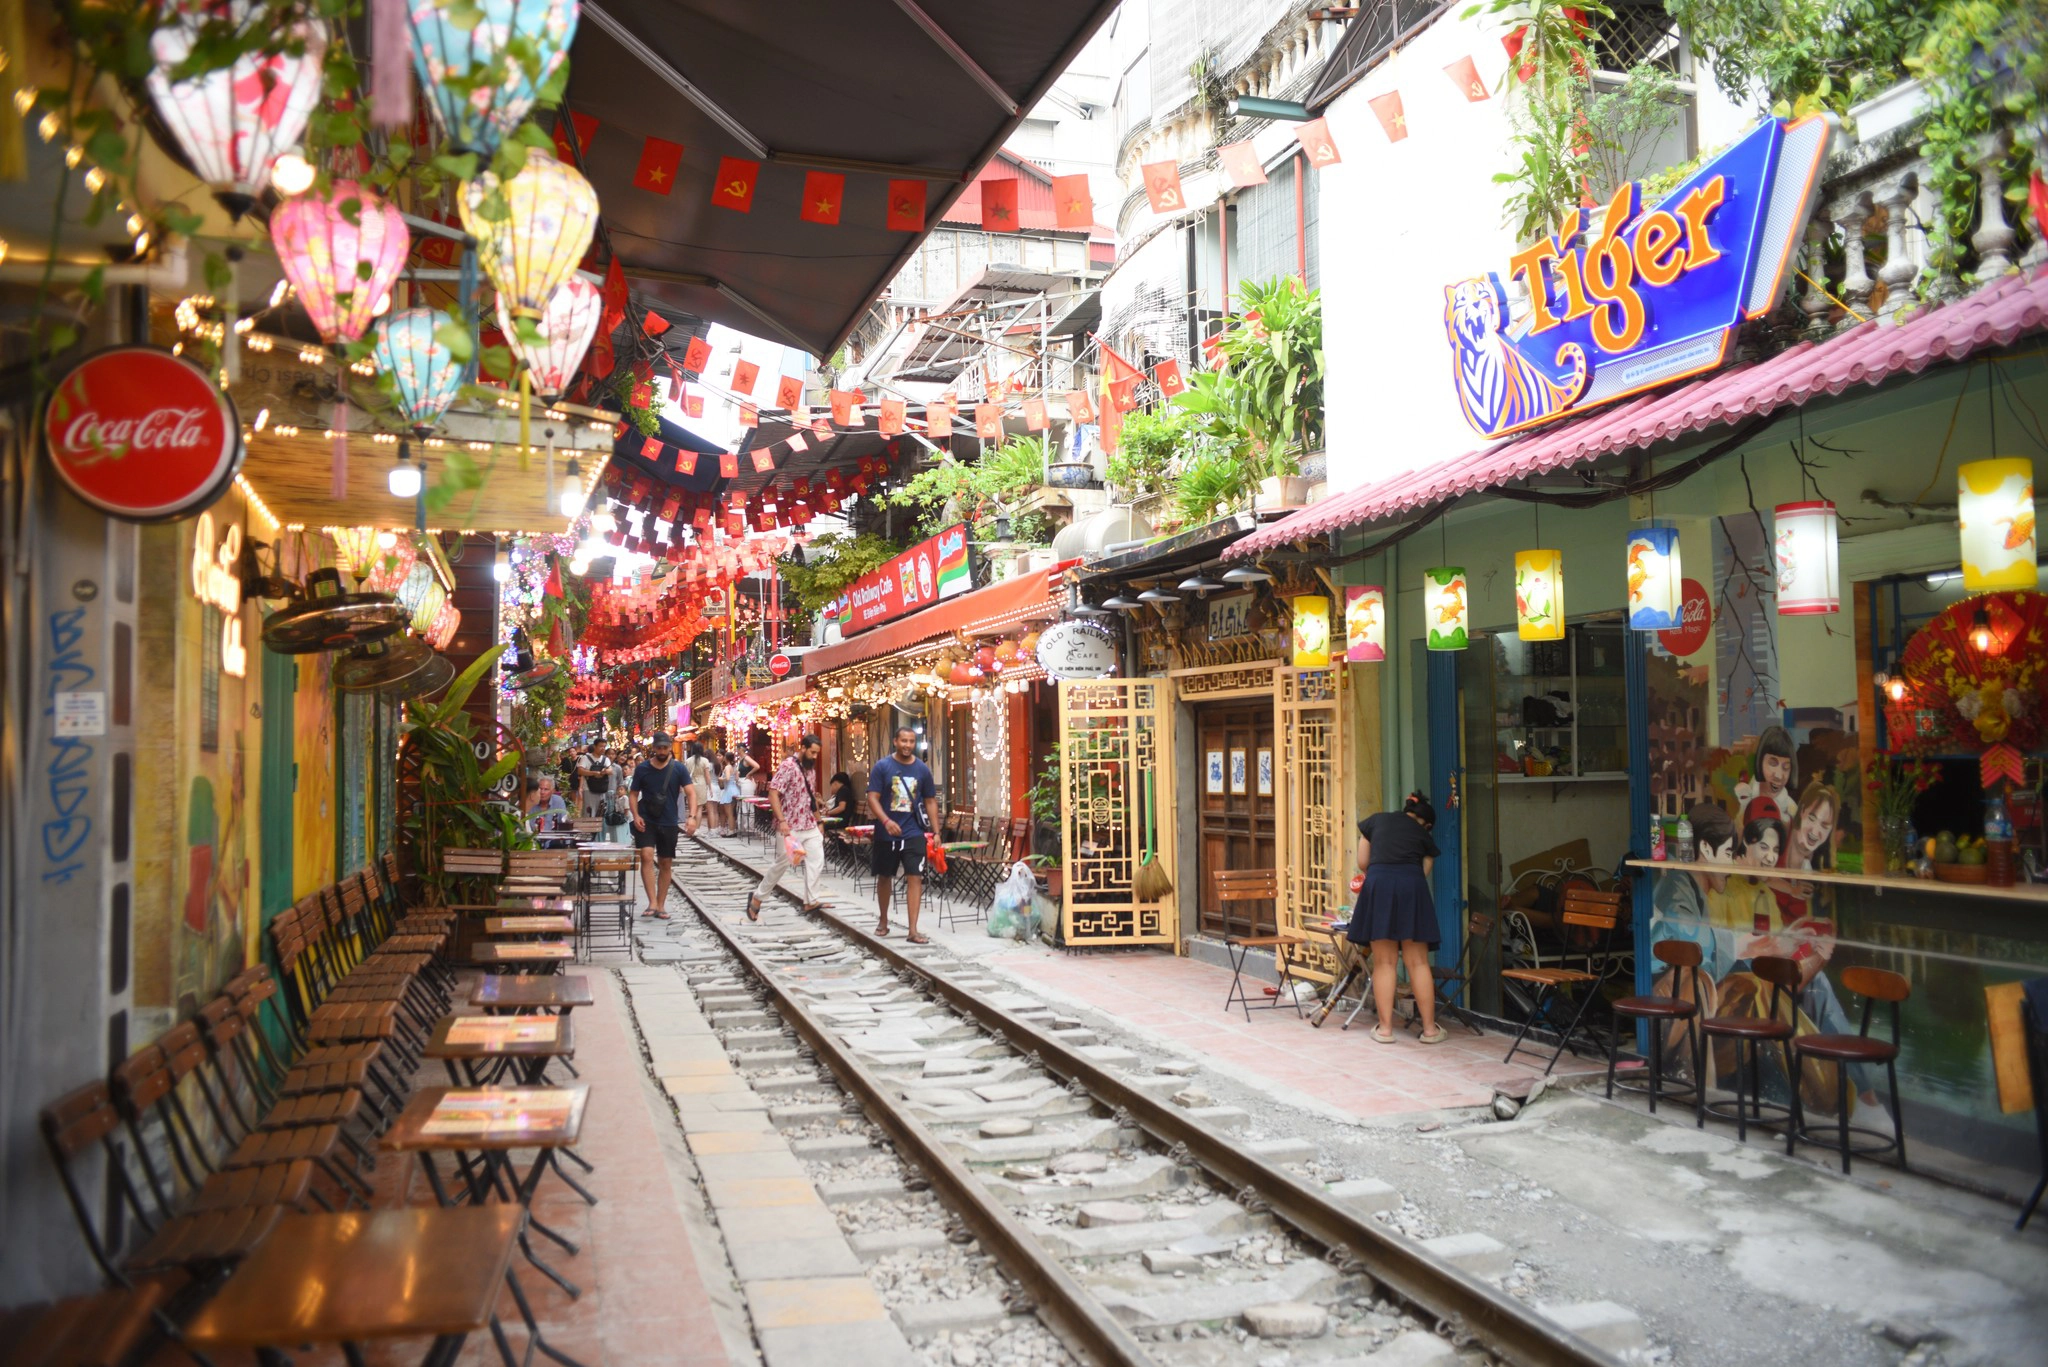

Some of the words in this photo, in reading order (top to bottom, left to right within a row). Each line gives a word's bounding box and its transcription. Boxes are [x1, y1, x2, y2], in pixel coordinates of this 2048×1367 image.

[1510, 175, 1725, 354] Tiger
[63, 407, 209, 453] Coca-Cola
[1046, 632, 1064, 650] OLD
[1072, 628, 1114, 650] RAILWAY
